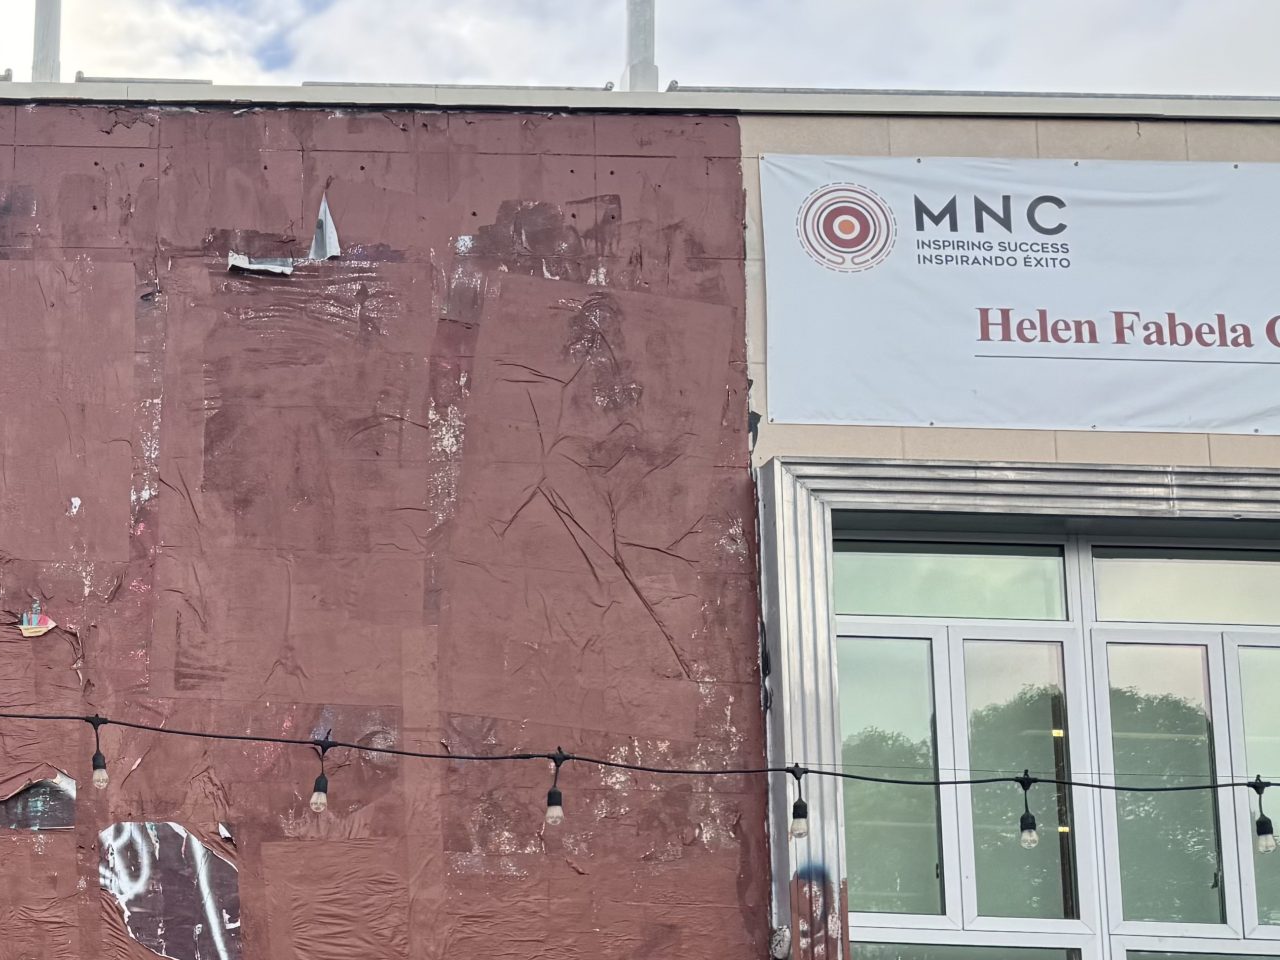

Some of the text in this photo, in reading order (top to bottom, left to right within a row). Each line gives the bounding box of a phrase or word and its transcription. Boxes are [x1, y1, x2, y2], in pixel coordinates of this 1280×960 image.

[914, 194, 1068, 236] MNC
[916, 239, 1070, 254] INSPIRING SUCCESS
[917, 254, 1071, 269] INSPIRANDO ÉXITO
[976, 307, 1100, 345] Helen
[1110, 310, 1255, 348] Fabela
